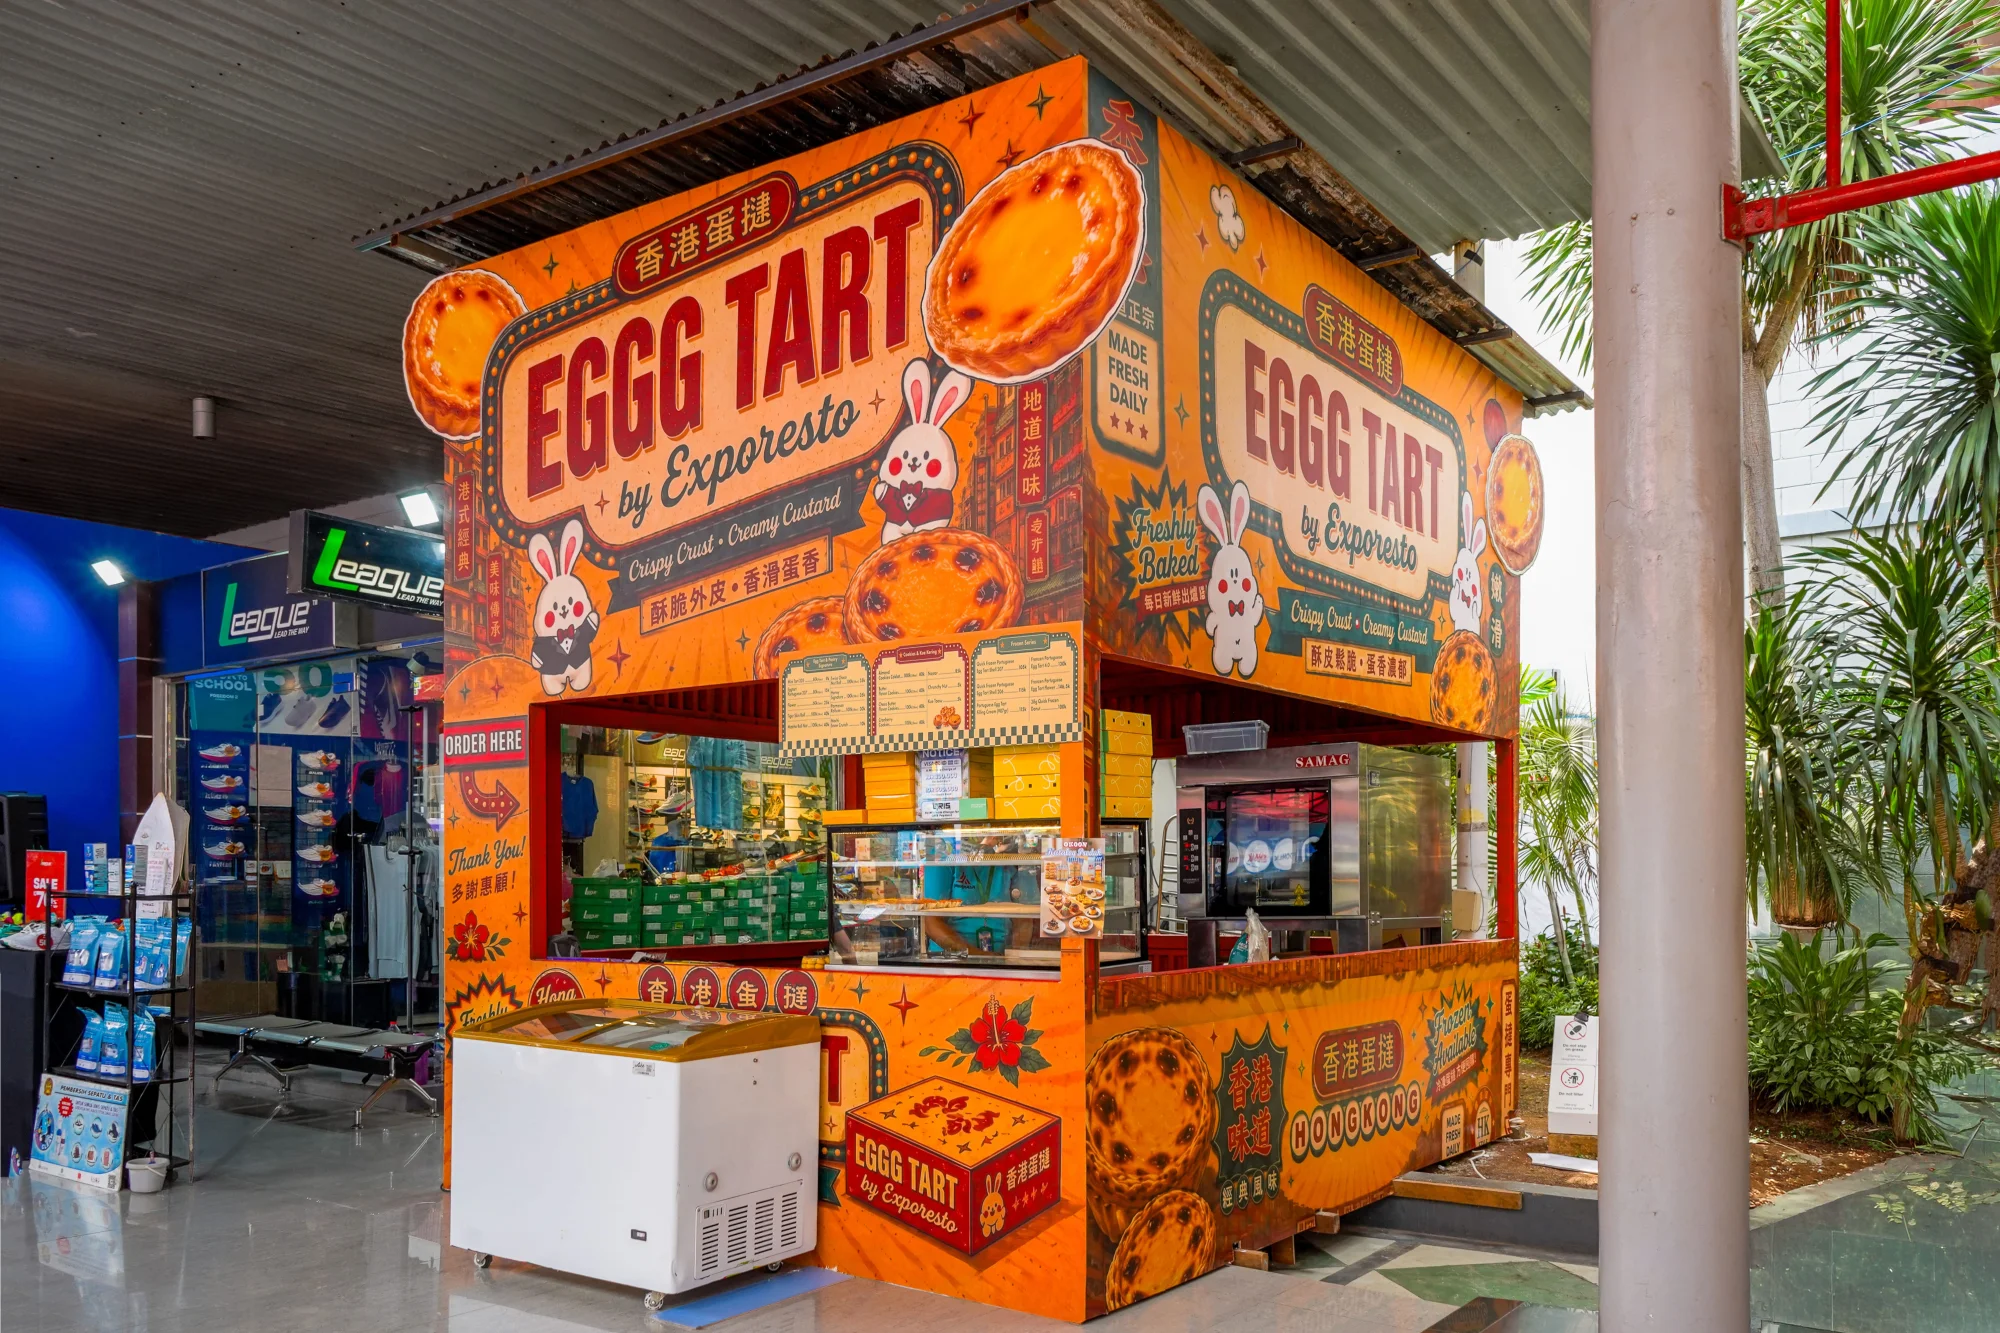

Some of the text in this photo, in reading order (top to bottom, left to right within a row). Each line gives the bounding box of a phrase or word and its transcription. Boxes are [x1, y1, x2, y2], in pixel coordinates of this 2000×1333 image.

[634, 190, 772, 282] 香港蛋撻
[527, 197, 922, 500] EGGG TART
[1108, 329, 1148, 365] MADE
[1315, 300, 1394, 385] 香港蛋撻
[1108, 355, 1149, 391] FRESH
[1110, 382, 1148, 415] DAILY
[618, 393, 860, 529] by Exporesto
[1022, 388, 1042, 497] 地道滋味
[1244, 338, 1443, 541] EGGG TART
[457, 482, 471, 572] 港式經典
[628, 486, 842, 582] Crispy Crust Creamy Custard
[1132, 508, 1197, 550] Freshly
[1301, 502, 1418, 571] by Exporesto
[312, 528, 444, 598] League
[1137, 544, 1200, 585] Baked
[218, 582, 310, 647] League
[397, 593, 444, 606] LEAD THE WAY
[489, 560, 501, 638] 美味傳承
[1291, 600, 1428, 645] Crispy Crust Creamy Custard
[274, 626, 309, 639] LEAD THE WAY
[195, 679, 252, 691] SCHOOL
[445, 730, 523, 756] ORDER HERE
[922, 750, 959, 758] NOTICE
[1295, 754, 1350, 768] SAMAG
[448, 835, 526, 876] Thank You!
[1433, 1002, 1472, 1049] Frozen
[1323, 1032, 1394, 1085] 香港蛋撻
[1432, 1026, 1477, 1076] Available
[87, 1090, 106, 1099] SEPATU
[1228, 1053, 1274, 1110] 香港
[1227, 1106, 1272, 1163] 味道
[1294, 1089, 1418, 1149] HONGKONG
[1446, 1114, 1461, 1128] MADE
[1446, 1128, 1461, 1143] FRESH
[1477, 1114, 1490, 1139] HK
[855, 1132, 958, 1210] EGGG TART
[1446, 1142, 1460, 1157] DAILY
[861, 1174, 958, 1234] by Exporesto
